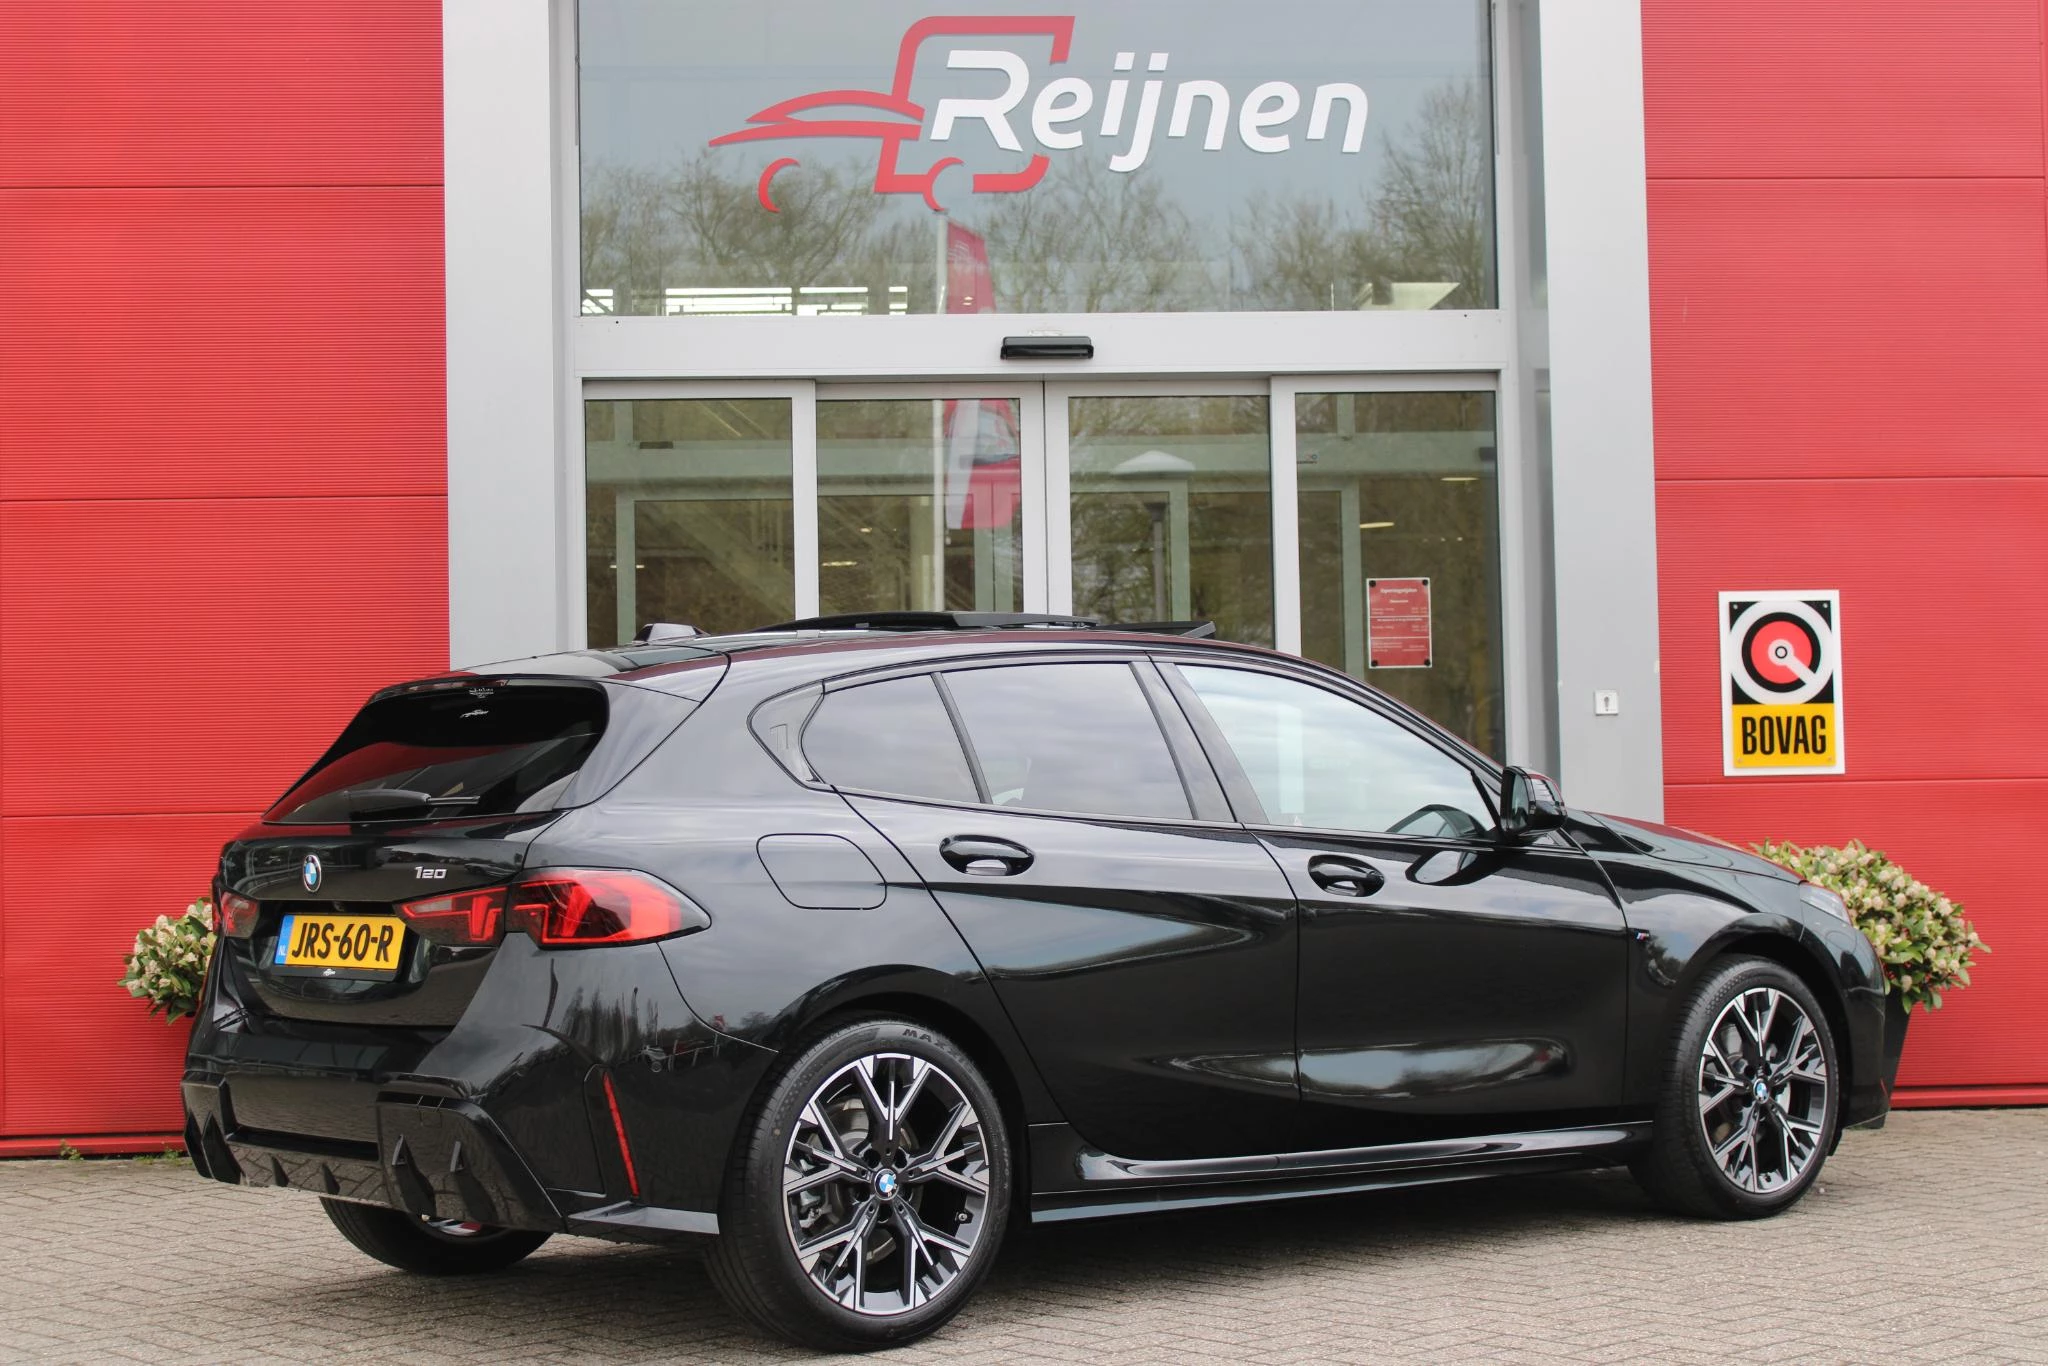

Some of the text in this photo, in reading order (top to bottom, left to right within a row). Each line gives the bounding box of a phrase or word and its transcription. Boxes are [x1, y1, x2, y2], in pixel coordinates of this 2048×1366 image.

[930, 50, 1369, 173] Reijnen
[1741, 715, 1827, 756] BOVAG
[415, 866, 448, 879] 120
[291, 922, 394, 963] JRS-60-R
